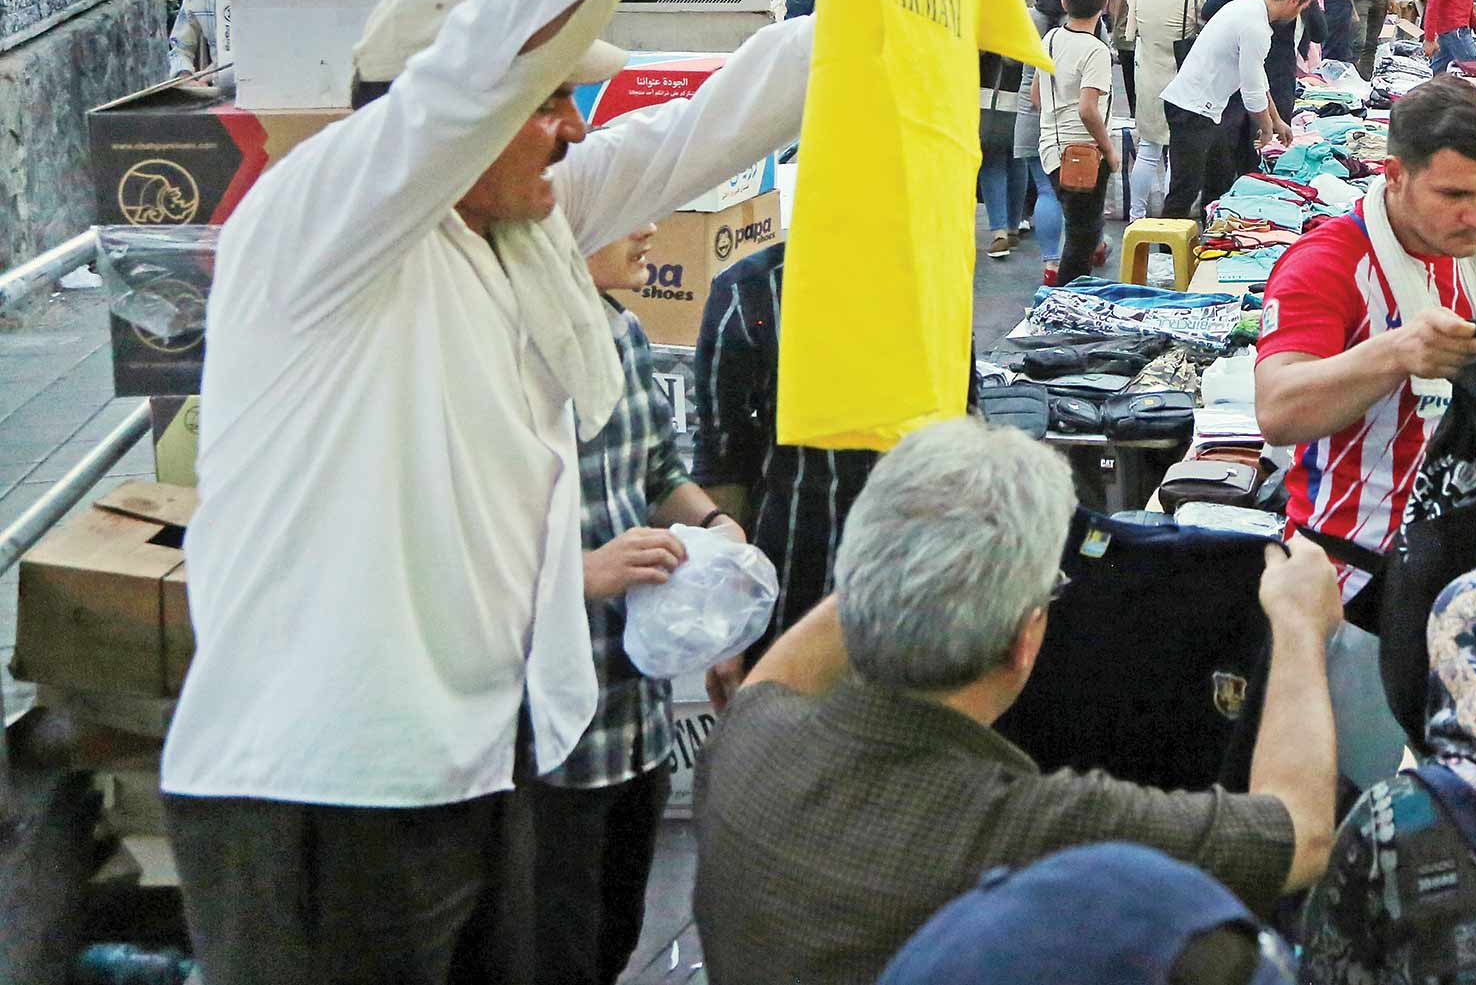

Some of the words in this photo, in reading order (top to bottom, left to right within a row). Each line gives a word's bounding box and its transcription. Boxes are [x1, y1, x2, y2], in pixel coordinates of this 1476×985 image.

[663, 76, 688, 89] الجودة
[734, 217, 772, 249] papa
[757, 232, 776, 244] shoes
[641, 286, 694, 301] shoes
[1101, 459, 1115, 468] CAT
